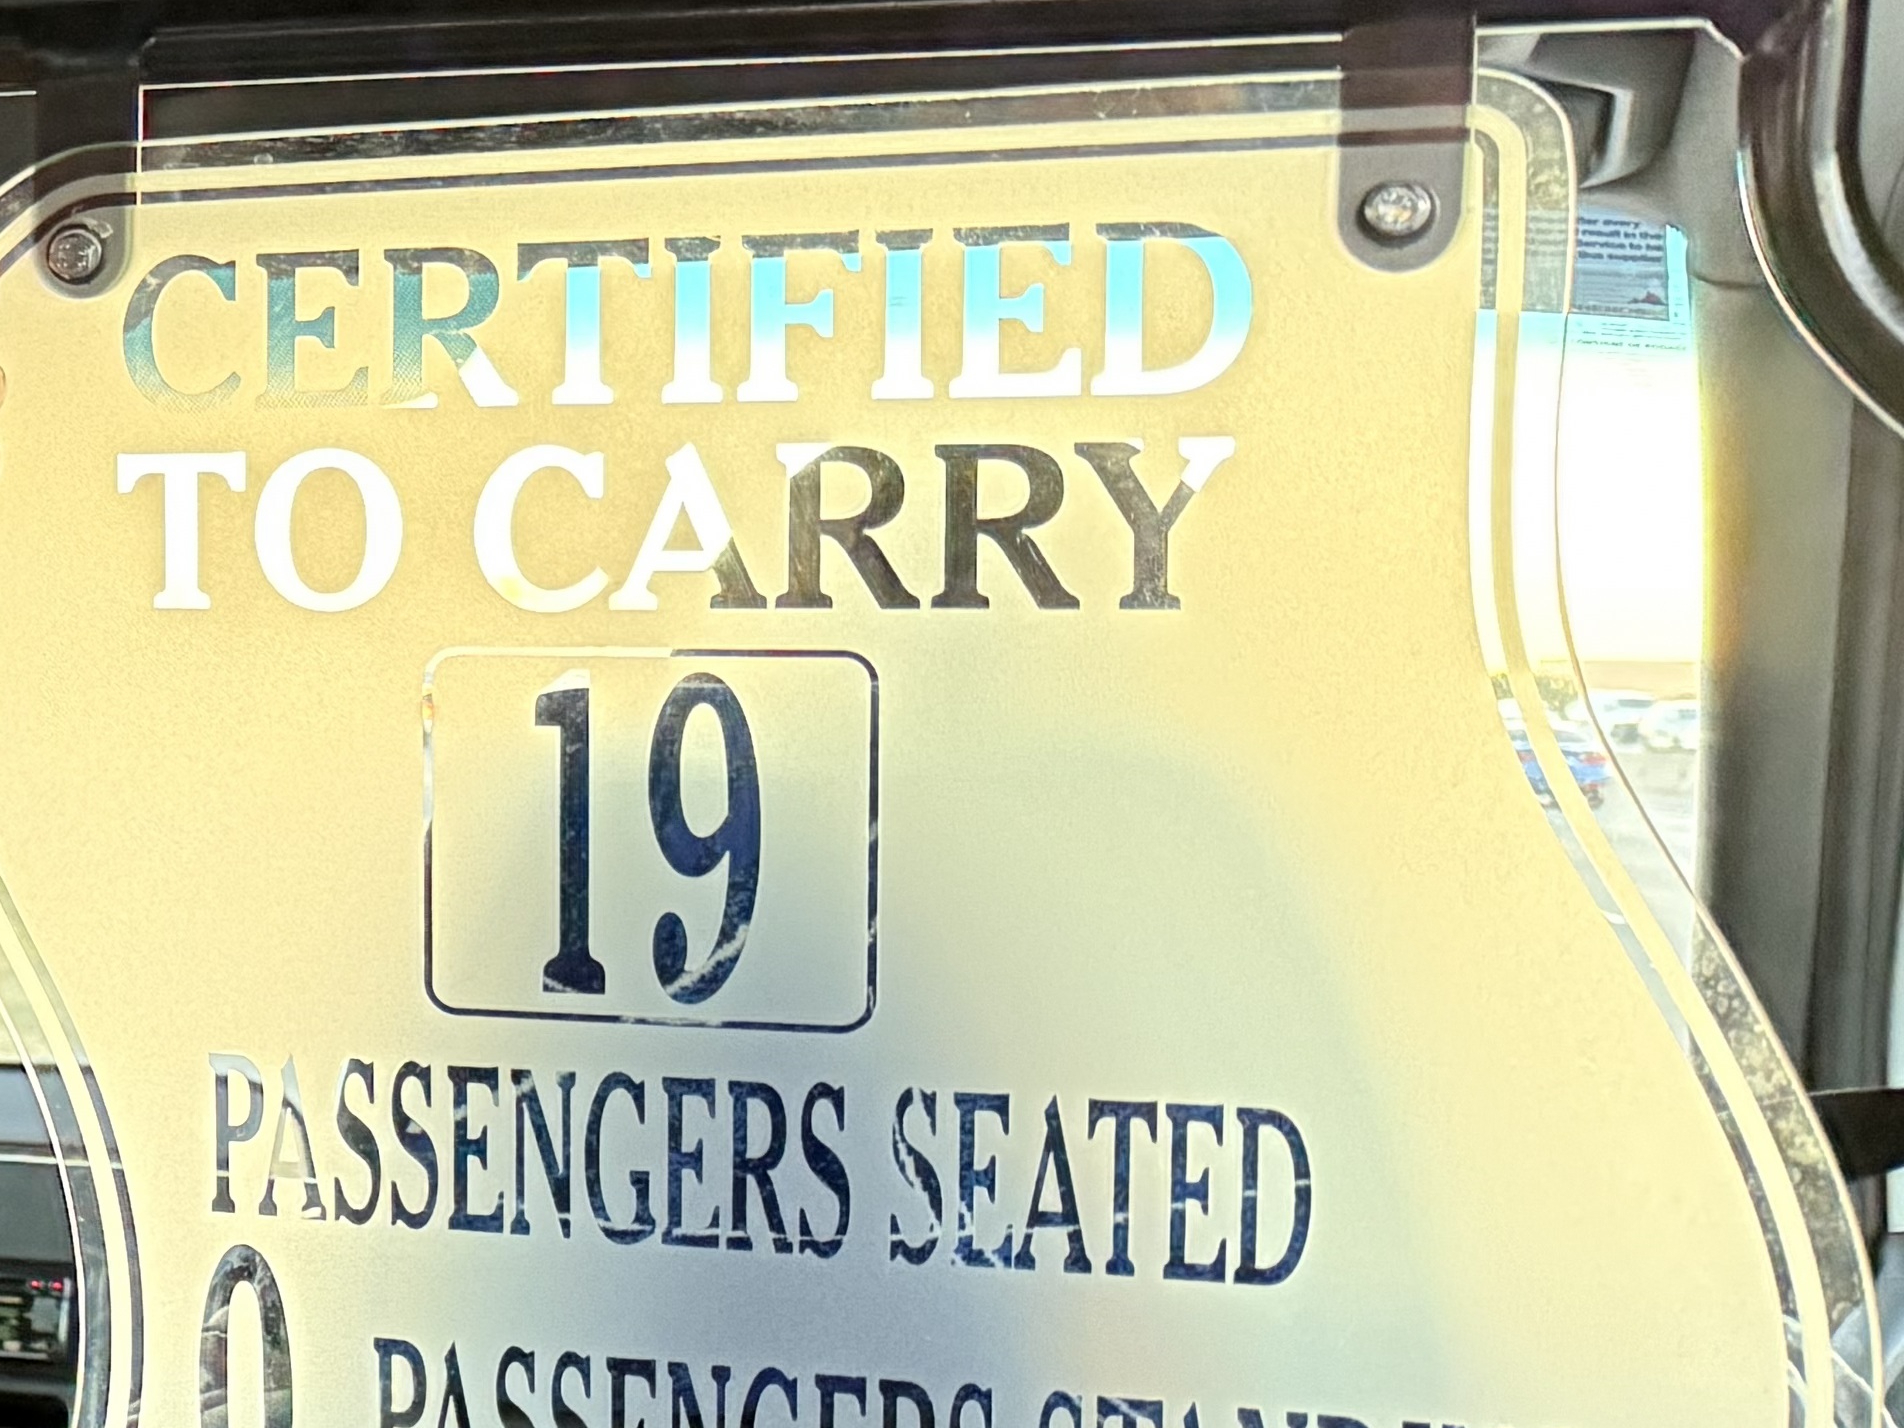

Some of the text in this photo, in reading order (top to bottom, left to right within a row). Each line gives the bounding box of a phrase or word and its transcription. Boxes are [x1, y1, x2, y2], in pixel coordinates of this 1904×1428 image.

[121, 221, 1254, 410] CERTIFIED
[116, 436, 1235, 614] TO CARRY
[535, 668, 761, 1004] 19
[209, 1052, 1313, 1286] PASSENGERS SEATED
